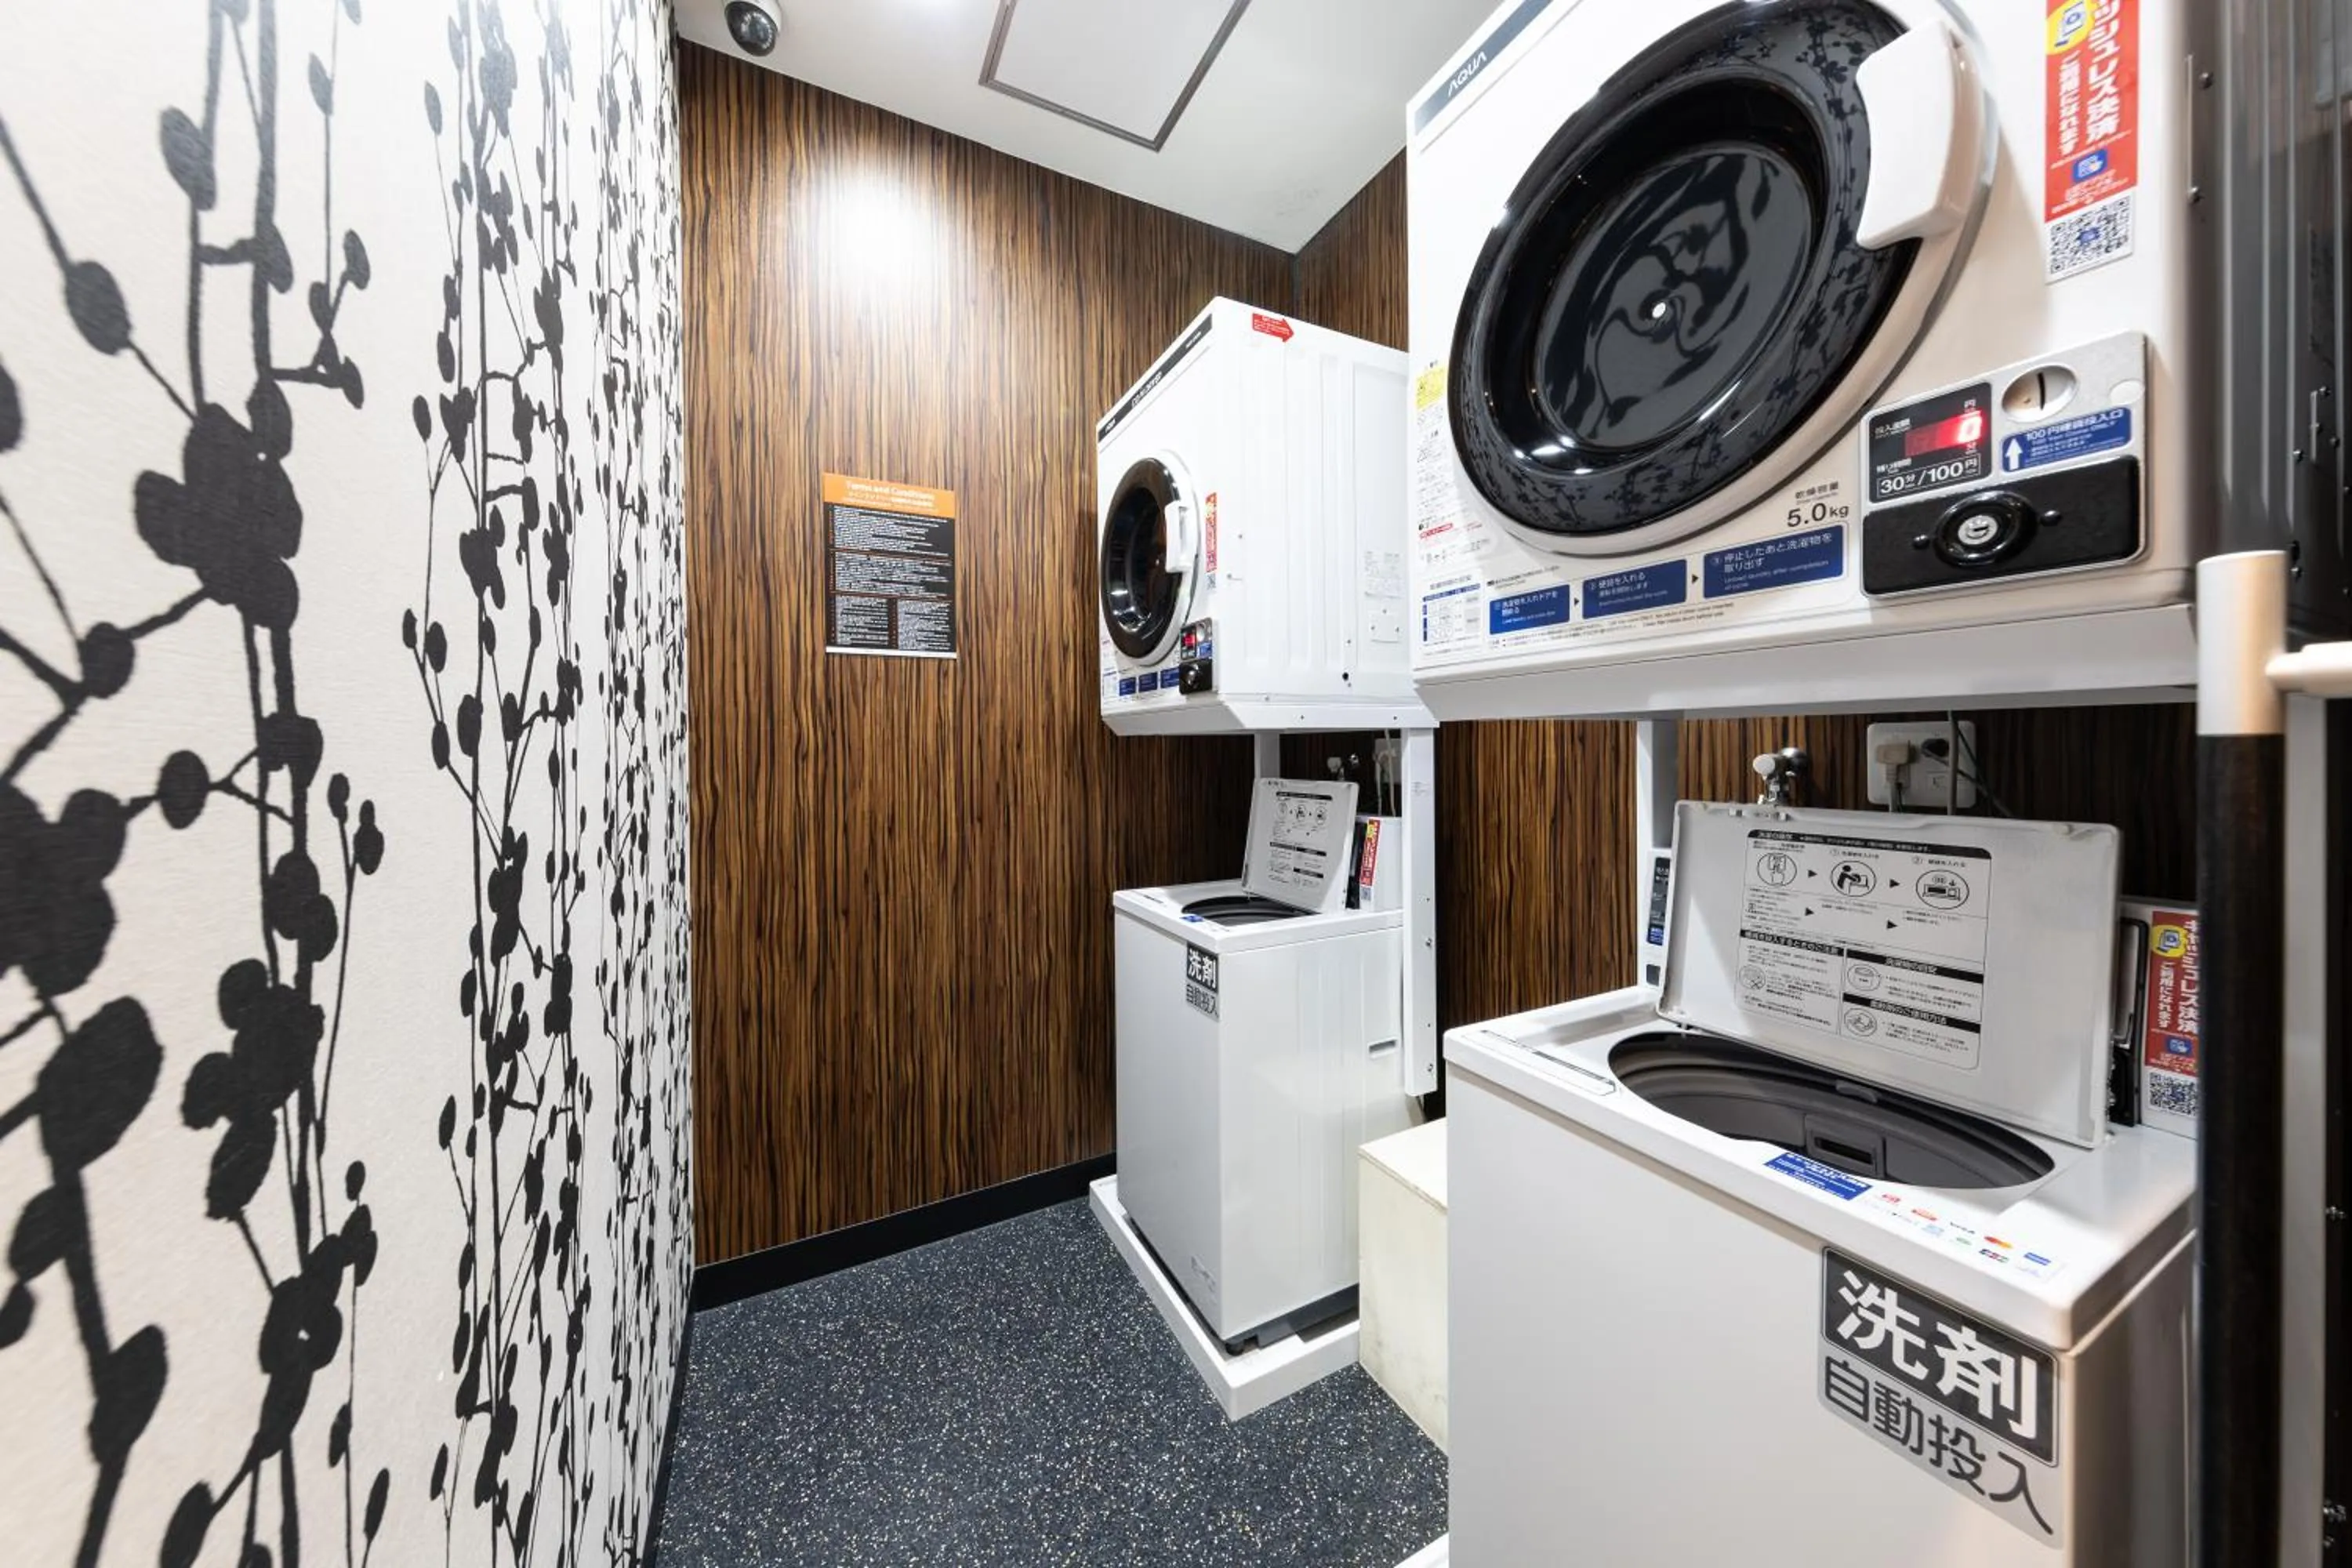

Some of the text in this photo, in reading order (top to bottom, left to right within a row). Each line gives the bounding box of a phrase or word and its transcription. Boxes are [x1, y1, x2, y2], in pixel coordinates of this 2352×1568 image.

[1449, 51, 1486, 97] AQUA
[1189, 948, 1216, 989] 洗剤
[1837, 1270, 2038, 1440] 洗剤
[1826, 1356, 2054, 1535] 自動投入
